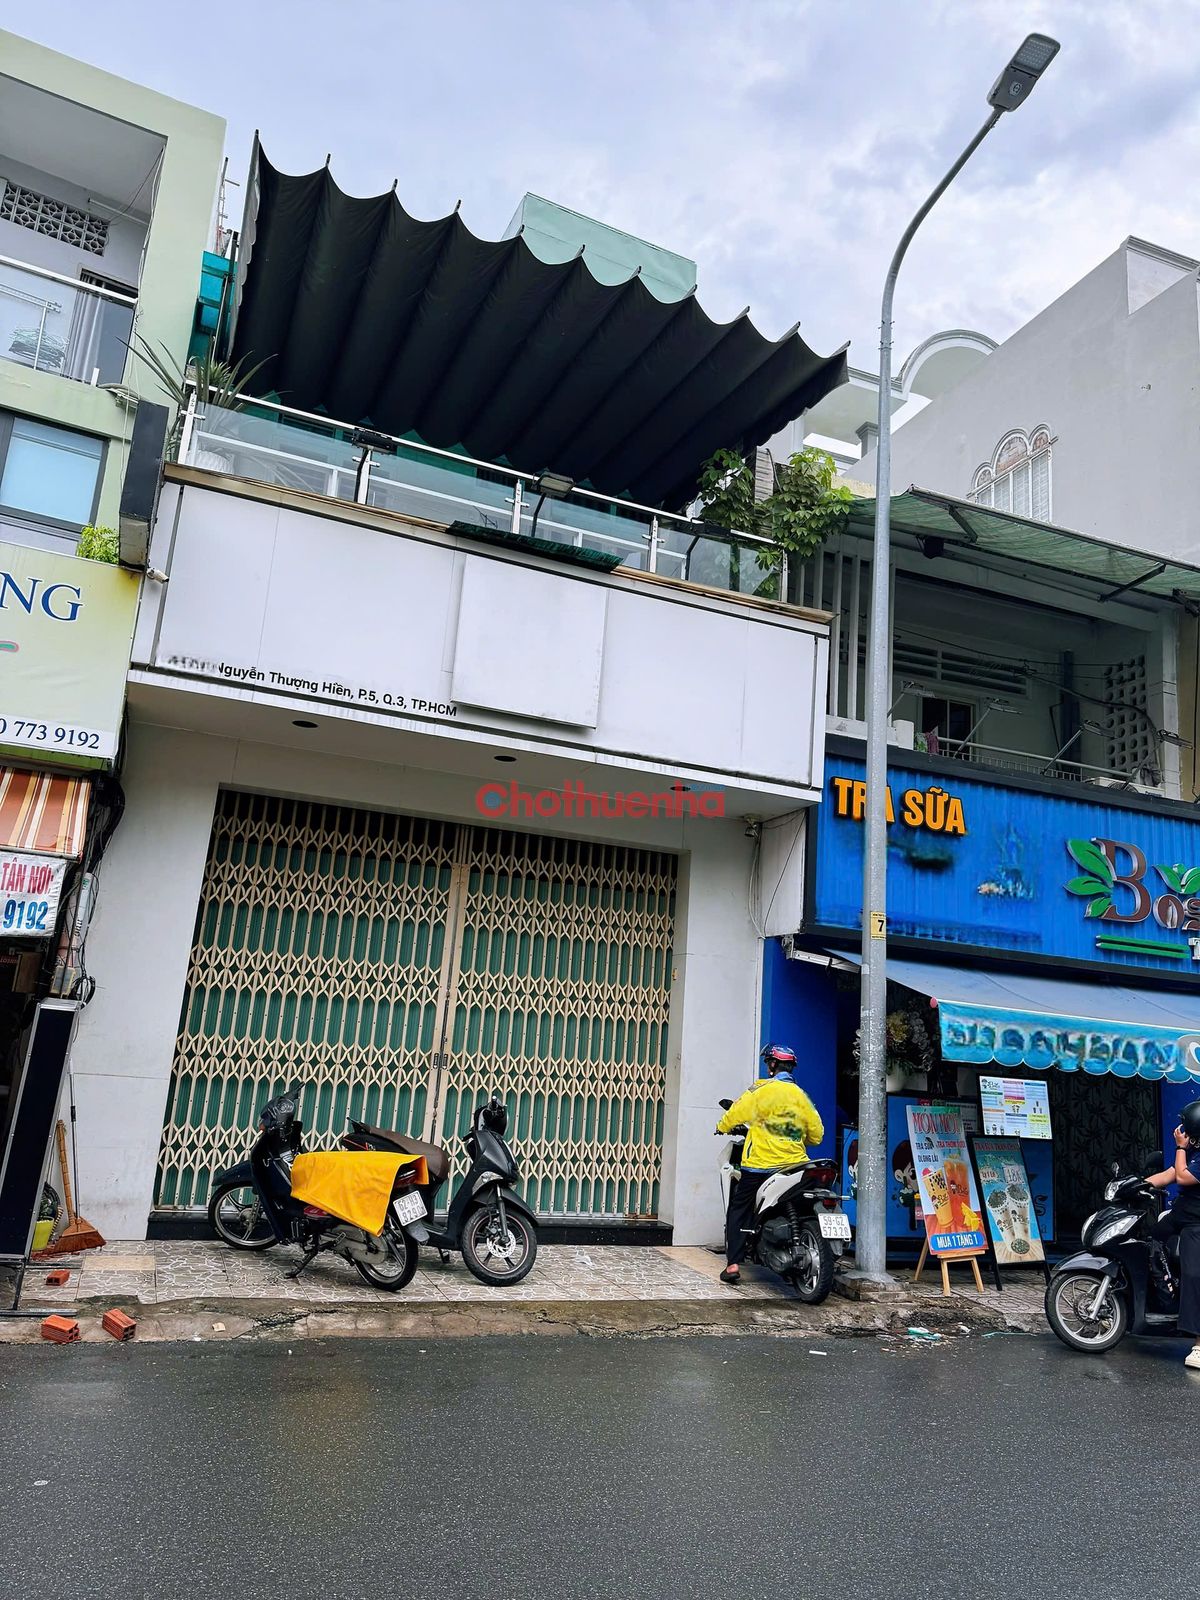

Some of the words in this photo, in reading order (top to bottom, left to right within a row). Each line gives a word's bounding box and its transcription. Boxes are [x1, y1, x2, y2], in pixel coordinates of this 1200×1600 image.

[269, 671, 319, 693] Thượng
[321, 681, 354, 699] Hiền,
[358, 688, 379, 704] P.5,
[382, 693, 407, 709] Q.3,
[411, 698, 457, 717] TP.HCM
[13, 721, 48, 741] 773
[53, 727, 100, 749] 9192
[903, 786, 966, 834] SỮA
[0, 857, 27, 898] TẬN
[3, 899, 49, 930] 9192
[877, 919, 885, 932] 7
[936, 1236, 952, 1249] MUA
